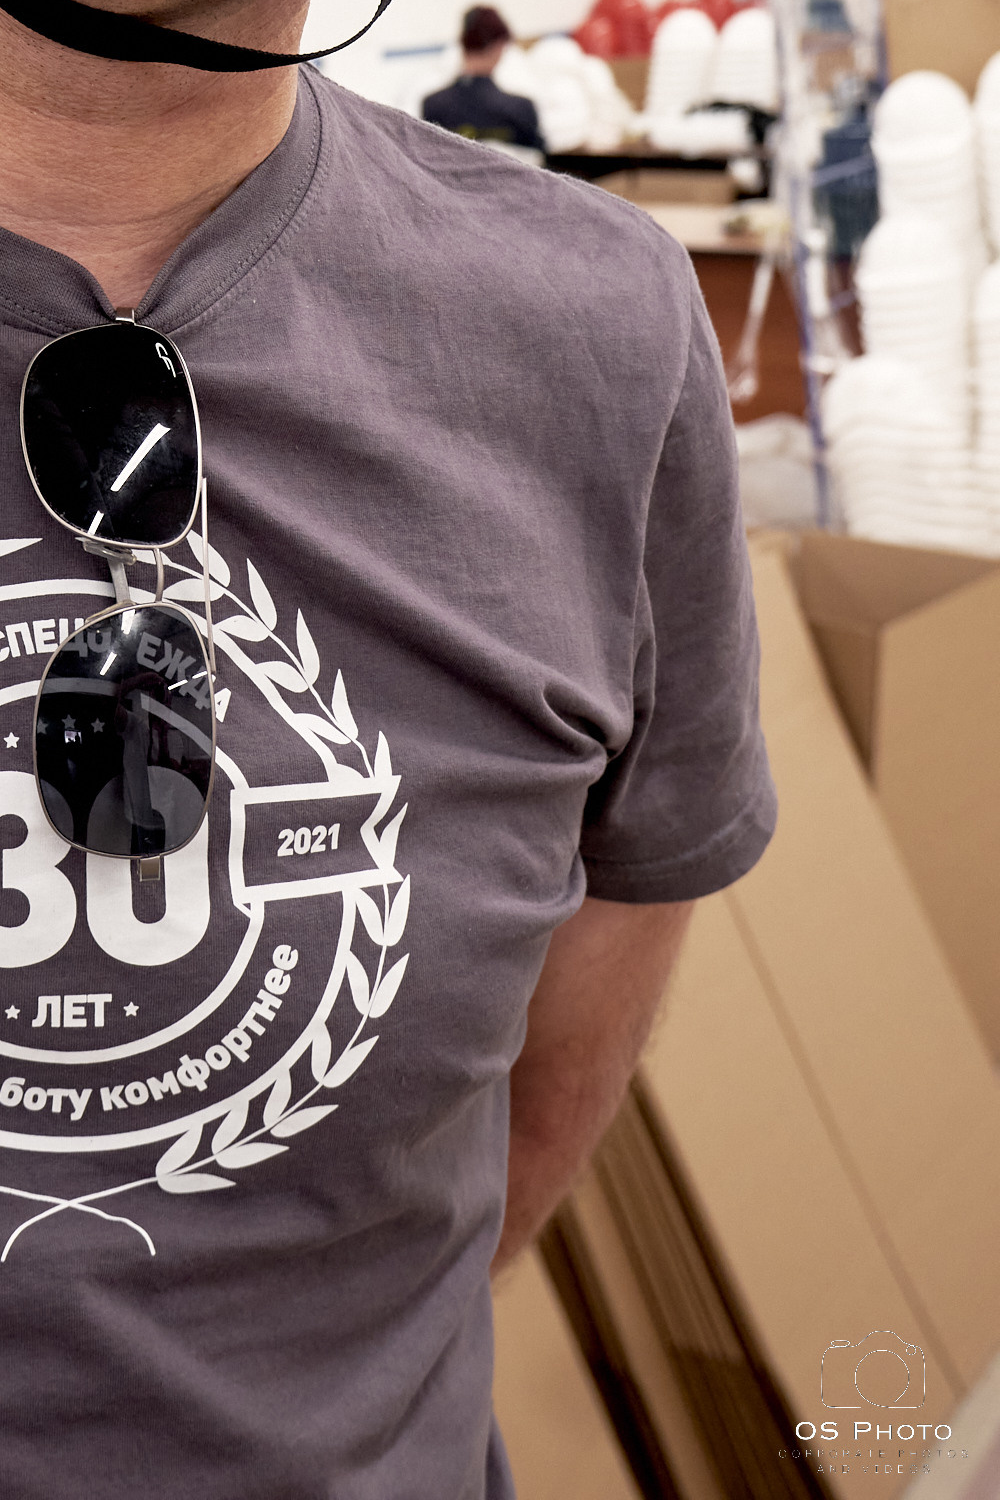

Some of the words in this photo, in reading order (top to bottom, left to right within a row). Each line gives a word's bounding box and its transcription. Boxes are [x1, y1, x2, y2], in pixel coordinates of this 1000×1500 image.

[276, 823, 341, 858] 2021
[31, 993, 113, 1029] ЛЕТ
[100, 943, 299, 1112] комфортнее
